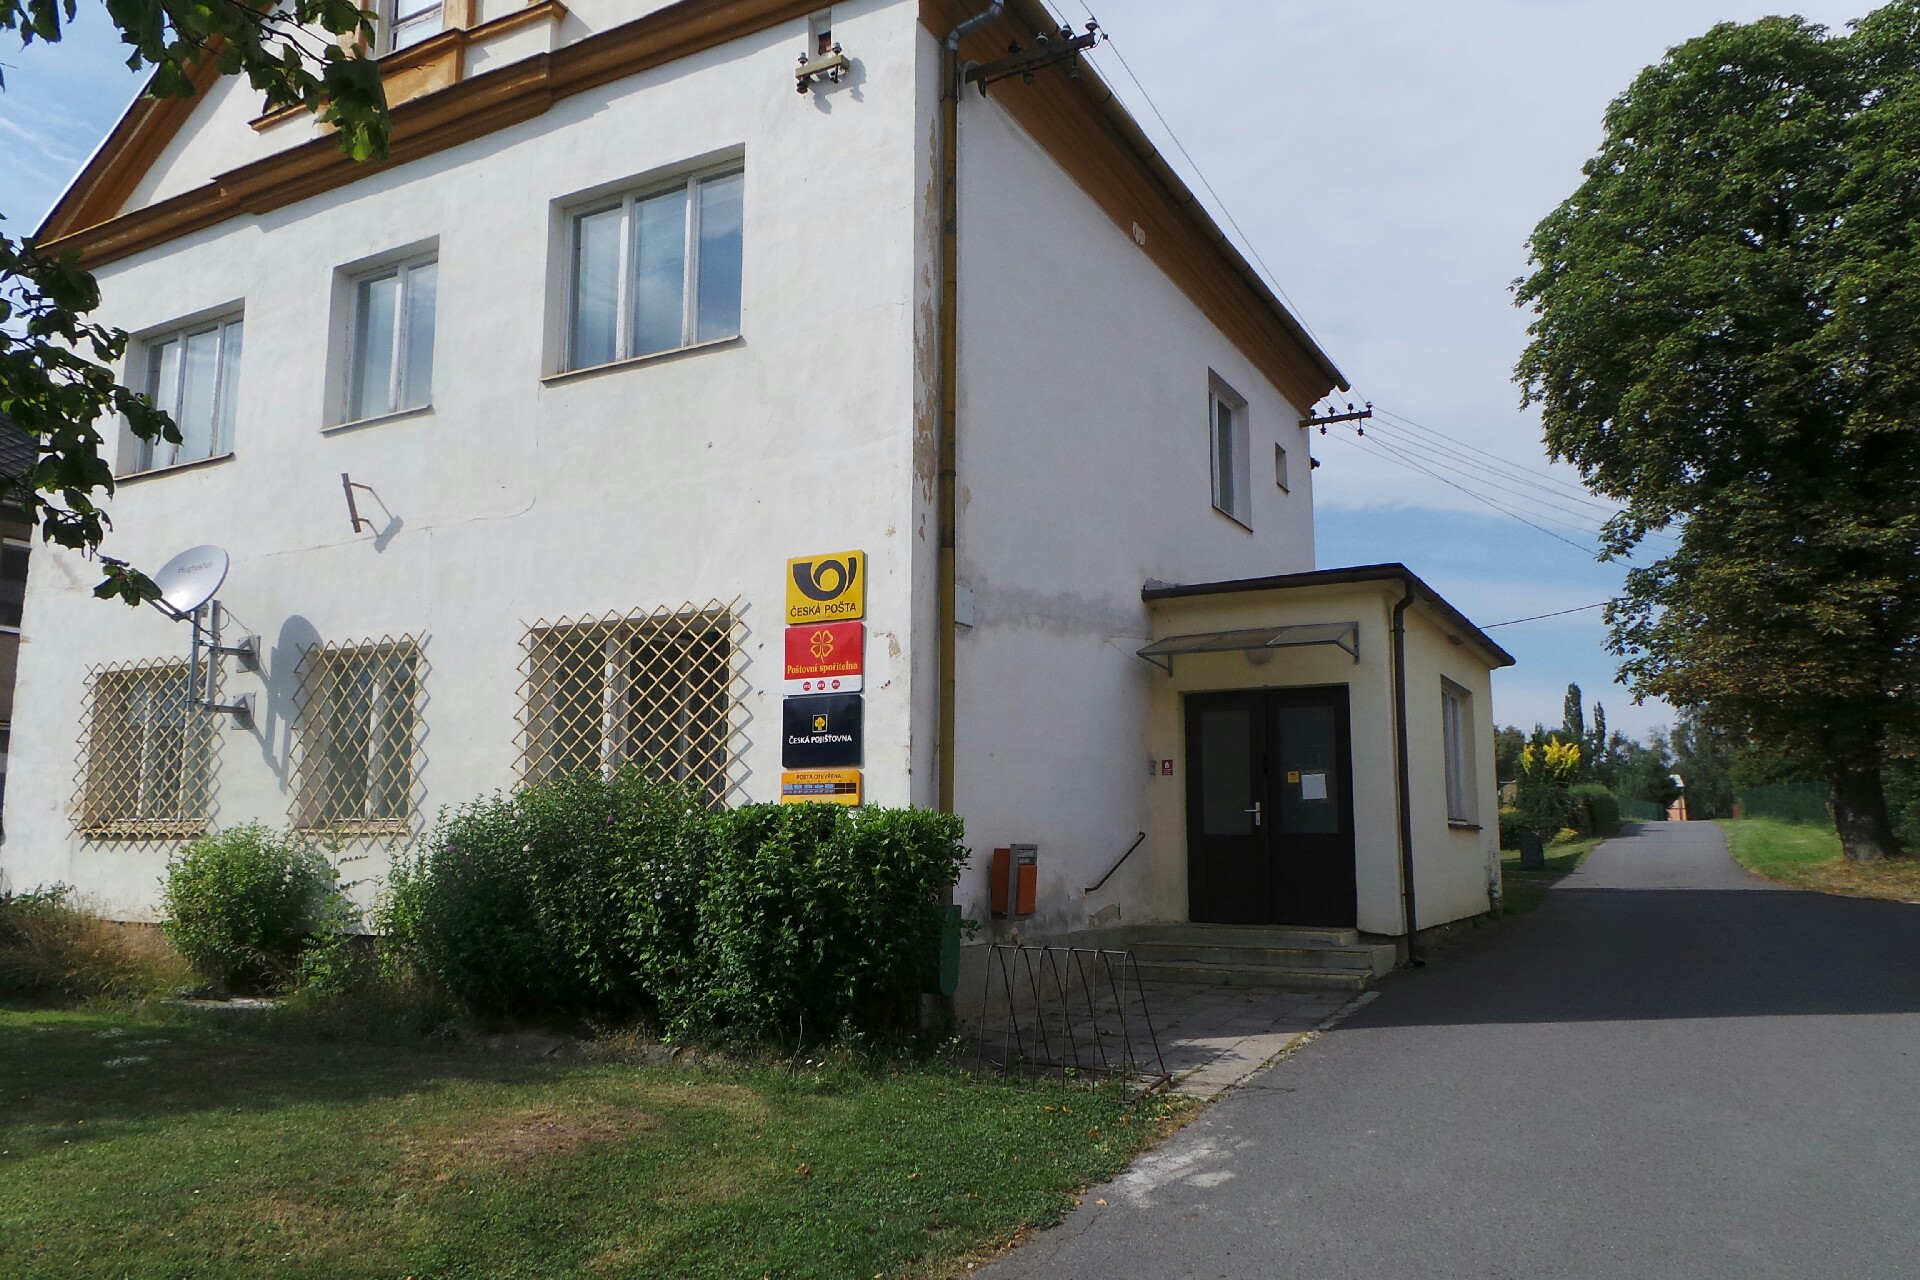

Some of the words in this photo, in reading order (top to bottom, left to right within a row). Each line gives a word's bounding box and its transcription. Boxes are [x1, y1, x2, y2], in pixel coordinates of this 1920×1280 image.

[790, 603, 821, 617] ČESKÁ
[824, 601, 857, 614] POŠTA
[787, 663, 818, 674] Poštovní
[819, 661, 858, 674] spořitelna
[788, 735, 810, 745] ČESKÁ
[811, 733, 853, 744] POJIŠŤOVNA
